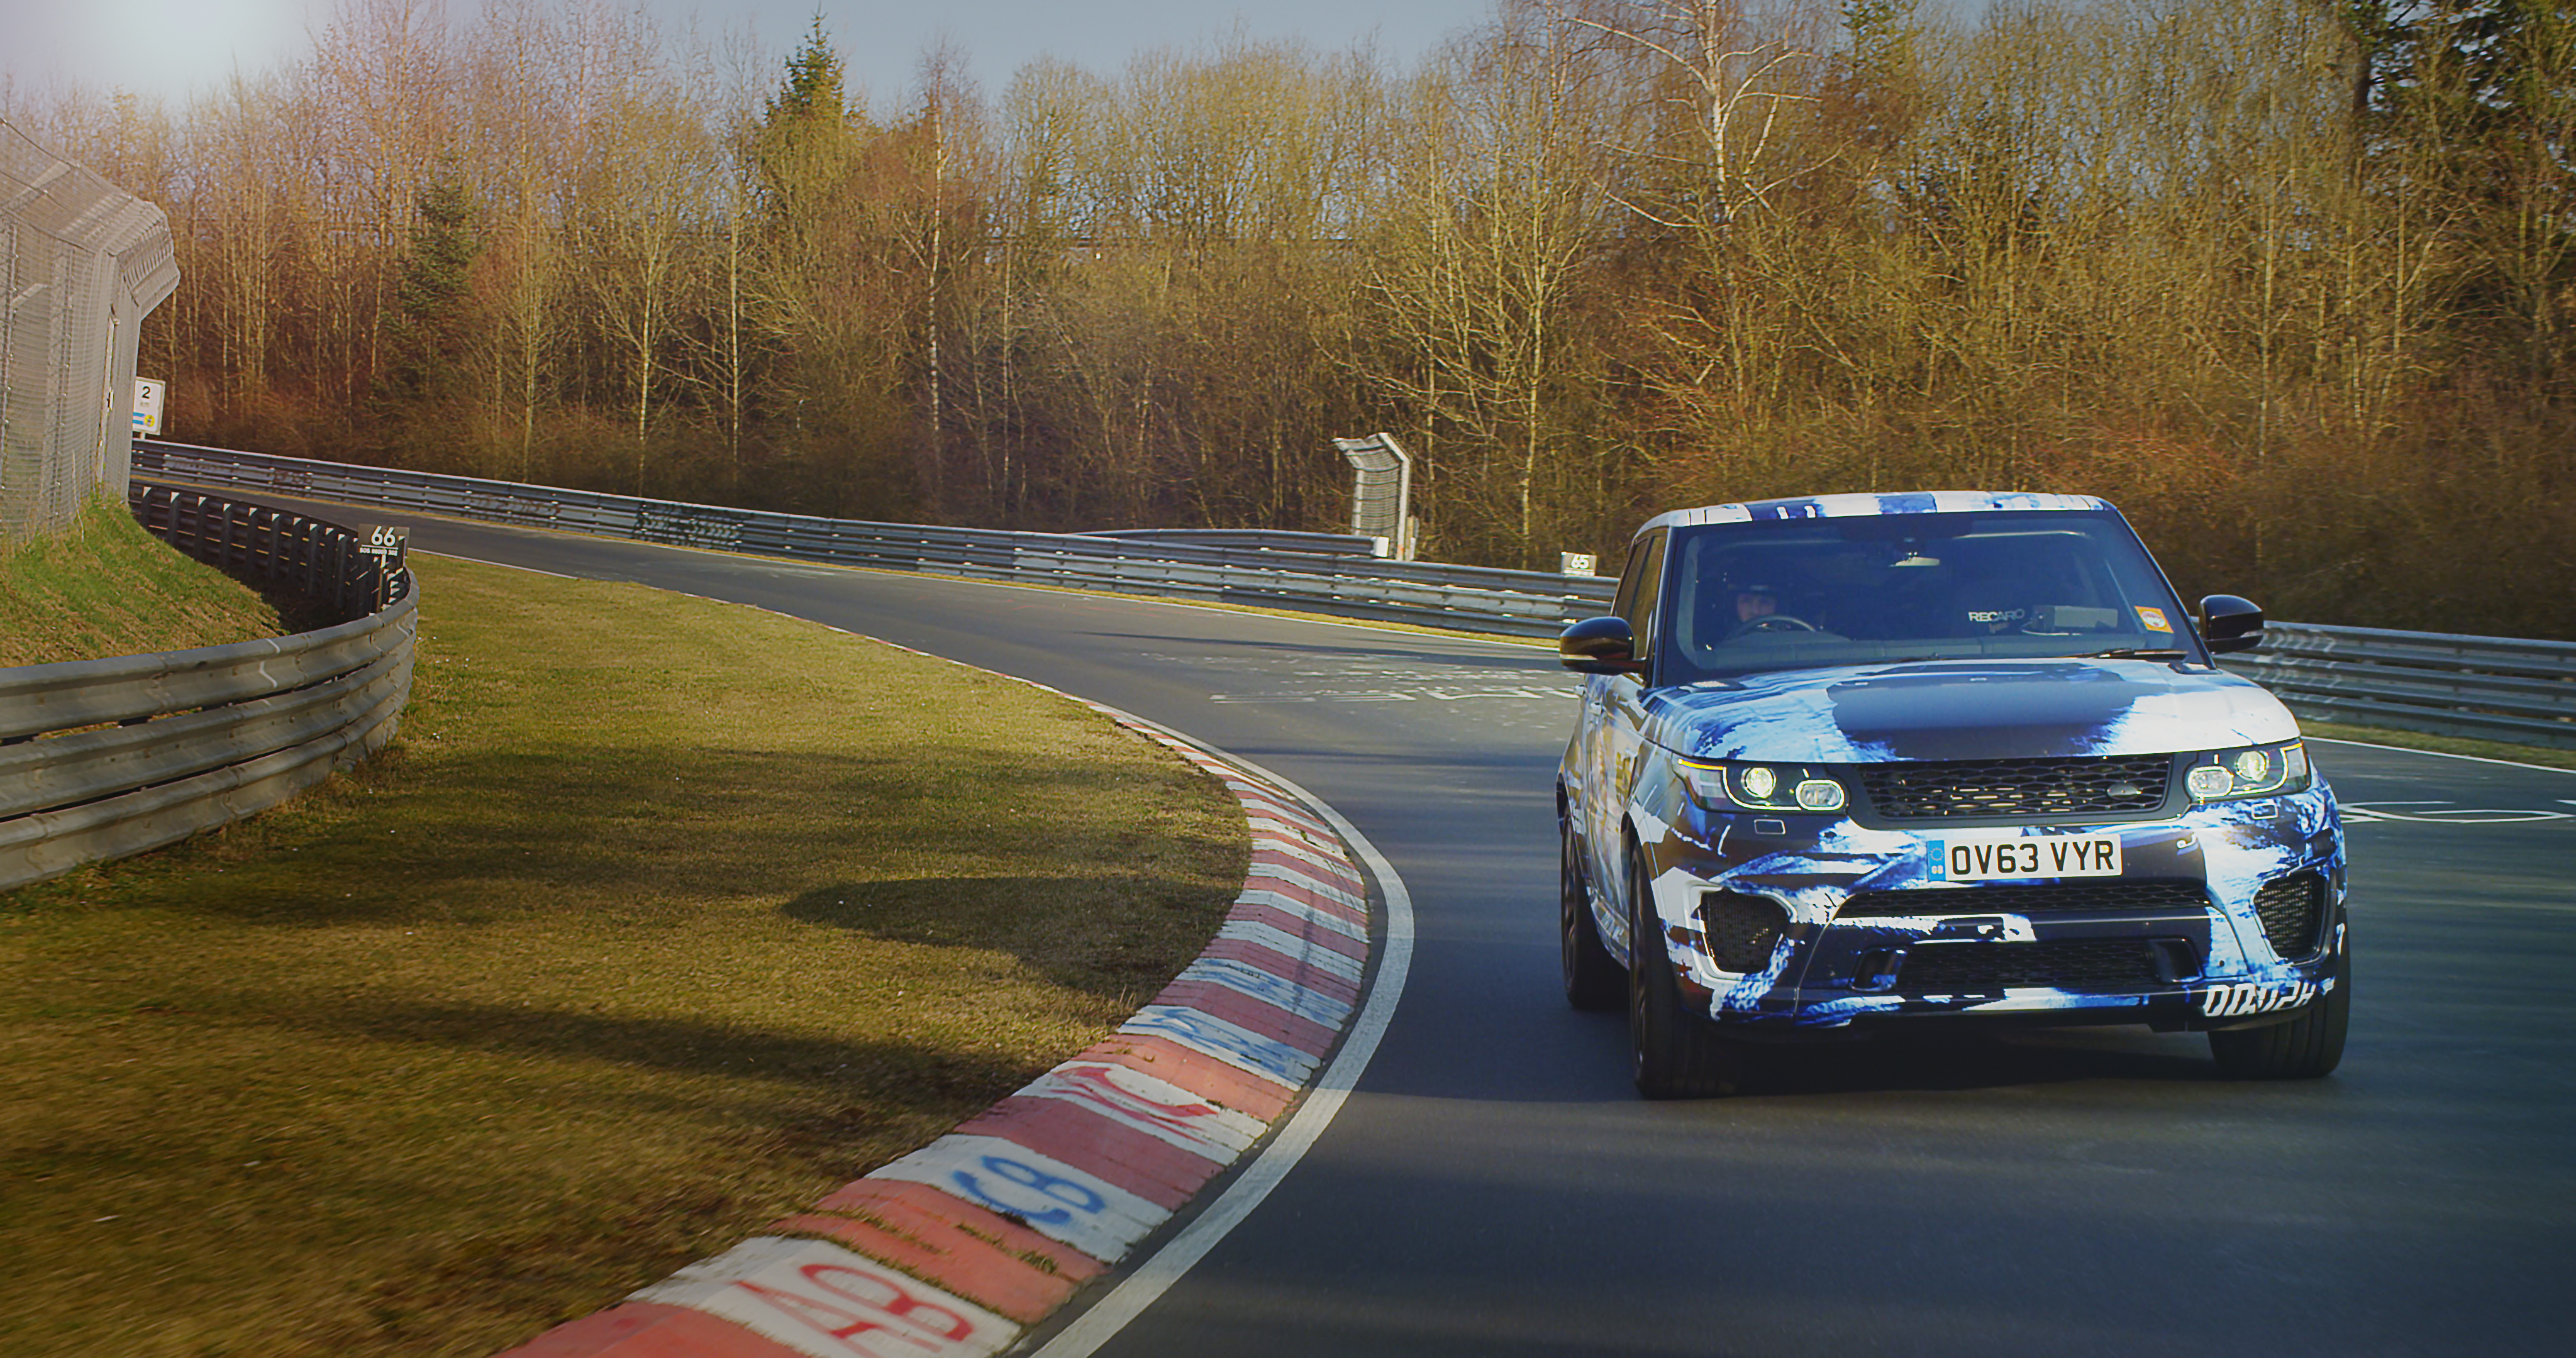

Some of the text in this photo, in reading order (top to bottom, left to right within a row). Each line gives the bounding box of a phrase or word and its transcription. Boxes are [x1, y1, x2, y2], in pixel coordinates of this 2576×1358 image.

[142, 385, 150, 399] 2
[371, 526, 395, 546] 66
[1571, 554, 1589, 570] 65
[1968, 608, 2024, 622] RECARO
[1951, 840, 2114, 875] OV63 VYR
[1931, 865, 1943, 875] GB
